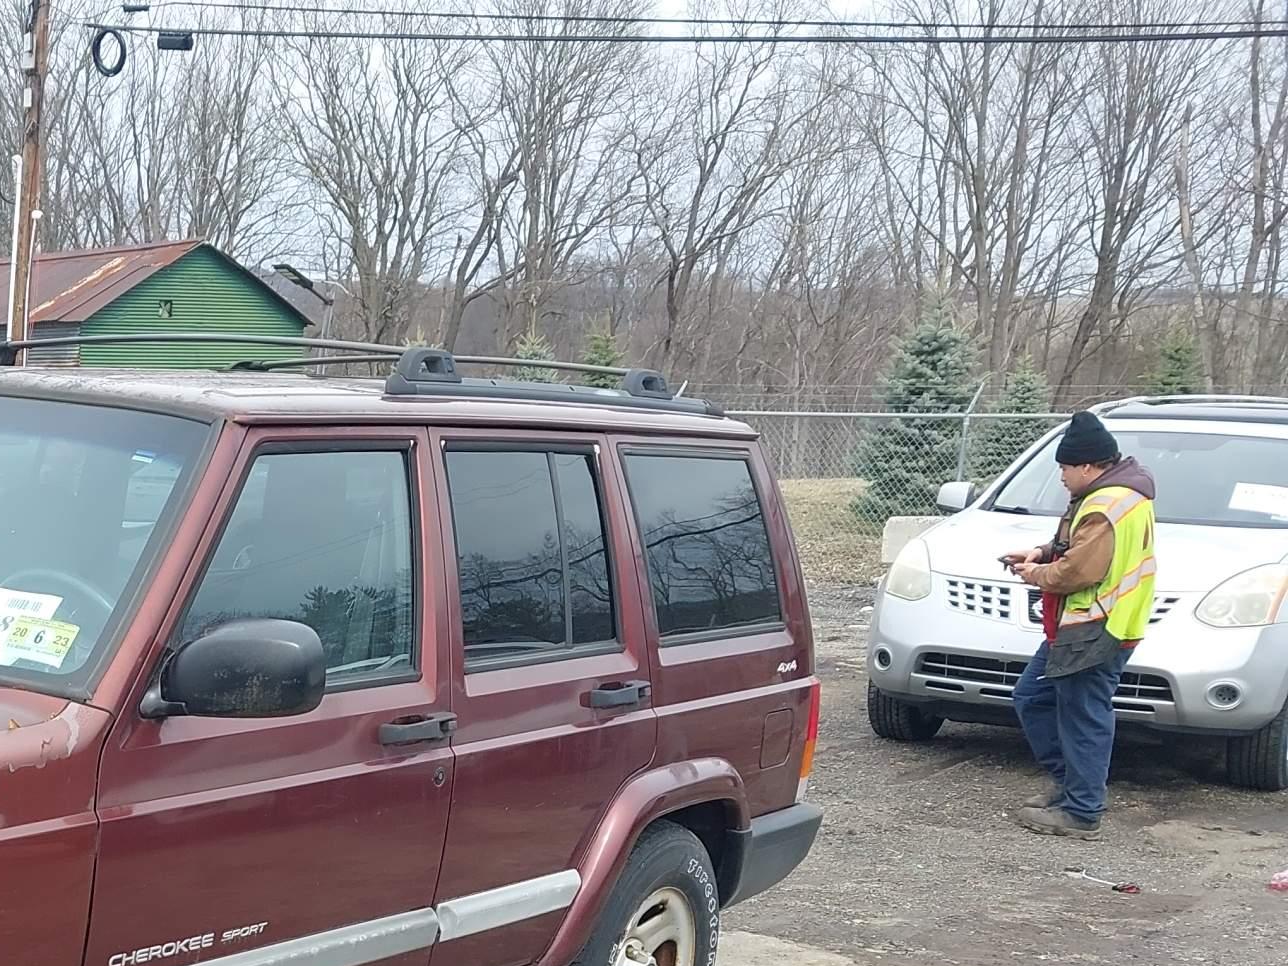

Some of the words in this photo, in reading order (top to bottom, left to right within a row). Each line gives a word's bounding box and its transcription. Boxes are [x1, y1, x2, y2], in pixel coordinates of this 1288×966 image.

[12, 626, 28, 638] 20
[33, 630, 46, 644] 6
[52, 635, 70, 647] 23
[220, 921, 269, 943] SPORT
